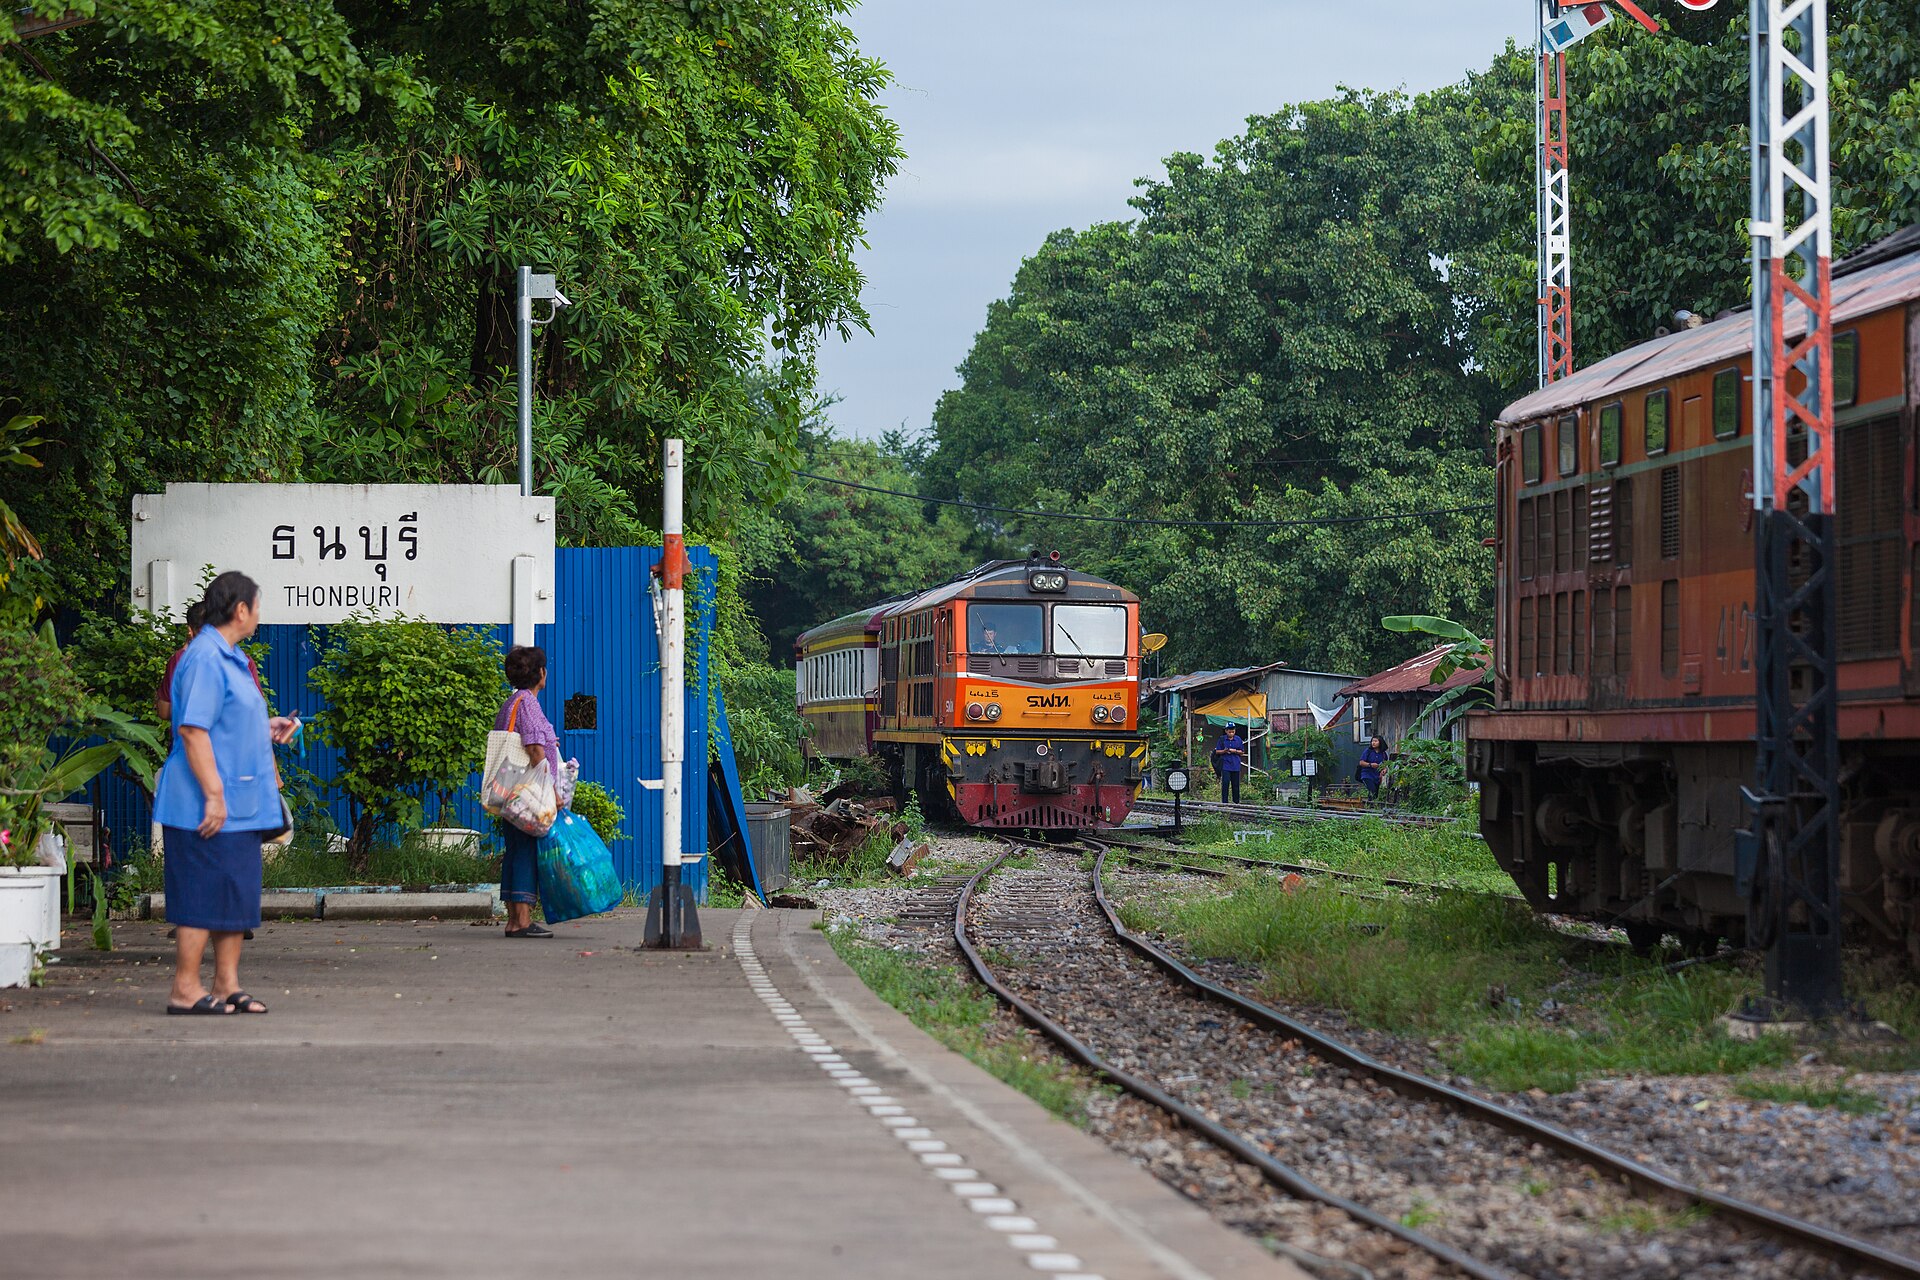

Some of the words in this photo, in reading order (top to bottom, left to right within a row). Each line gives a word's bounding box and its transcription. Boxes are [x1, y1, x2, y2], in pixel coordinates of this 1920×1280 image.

[272, 512, 418, 582] ธนบุรี
[284, 586, 399, 607] THONBURI
[1716, 601, 1757, 675] 412
